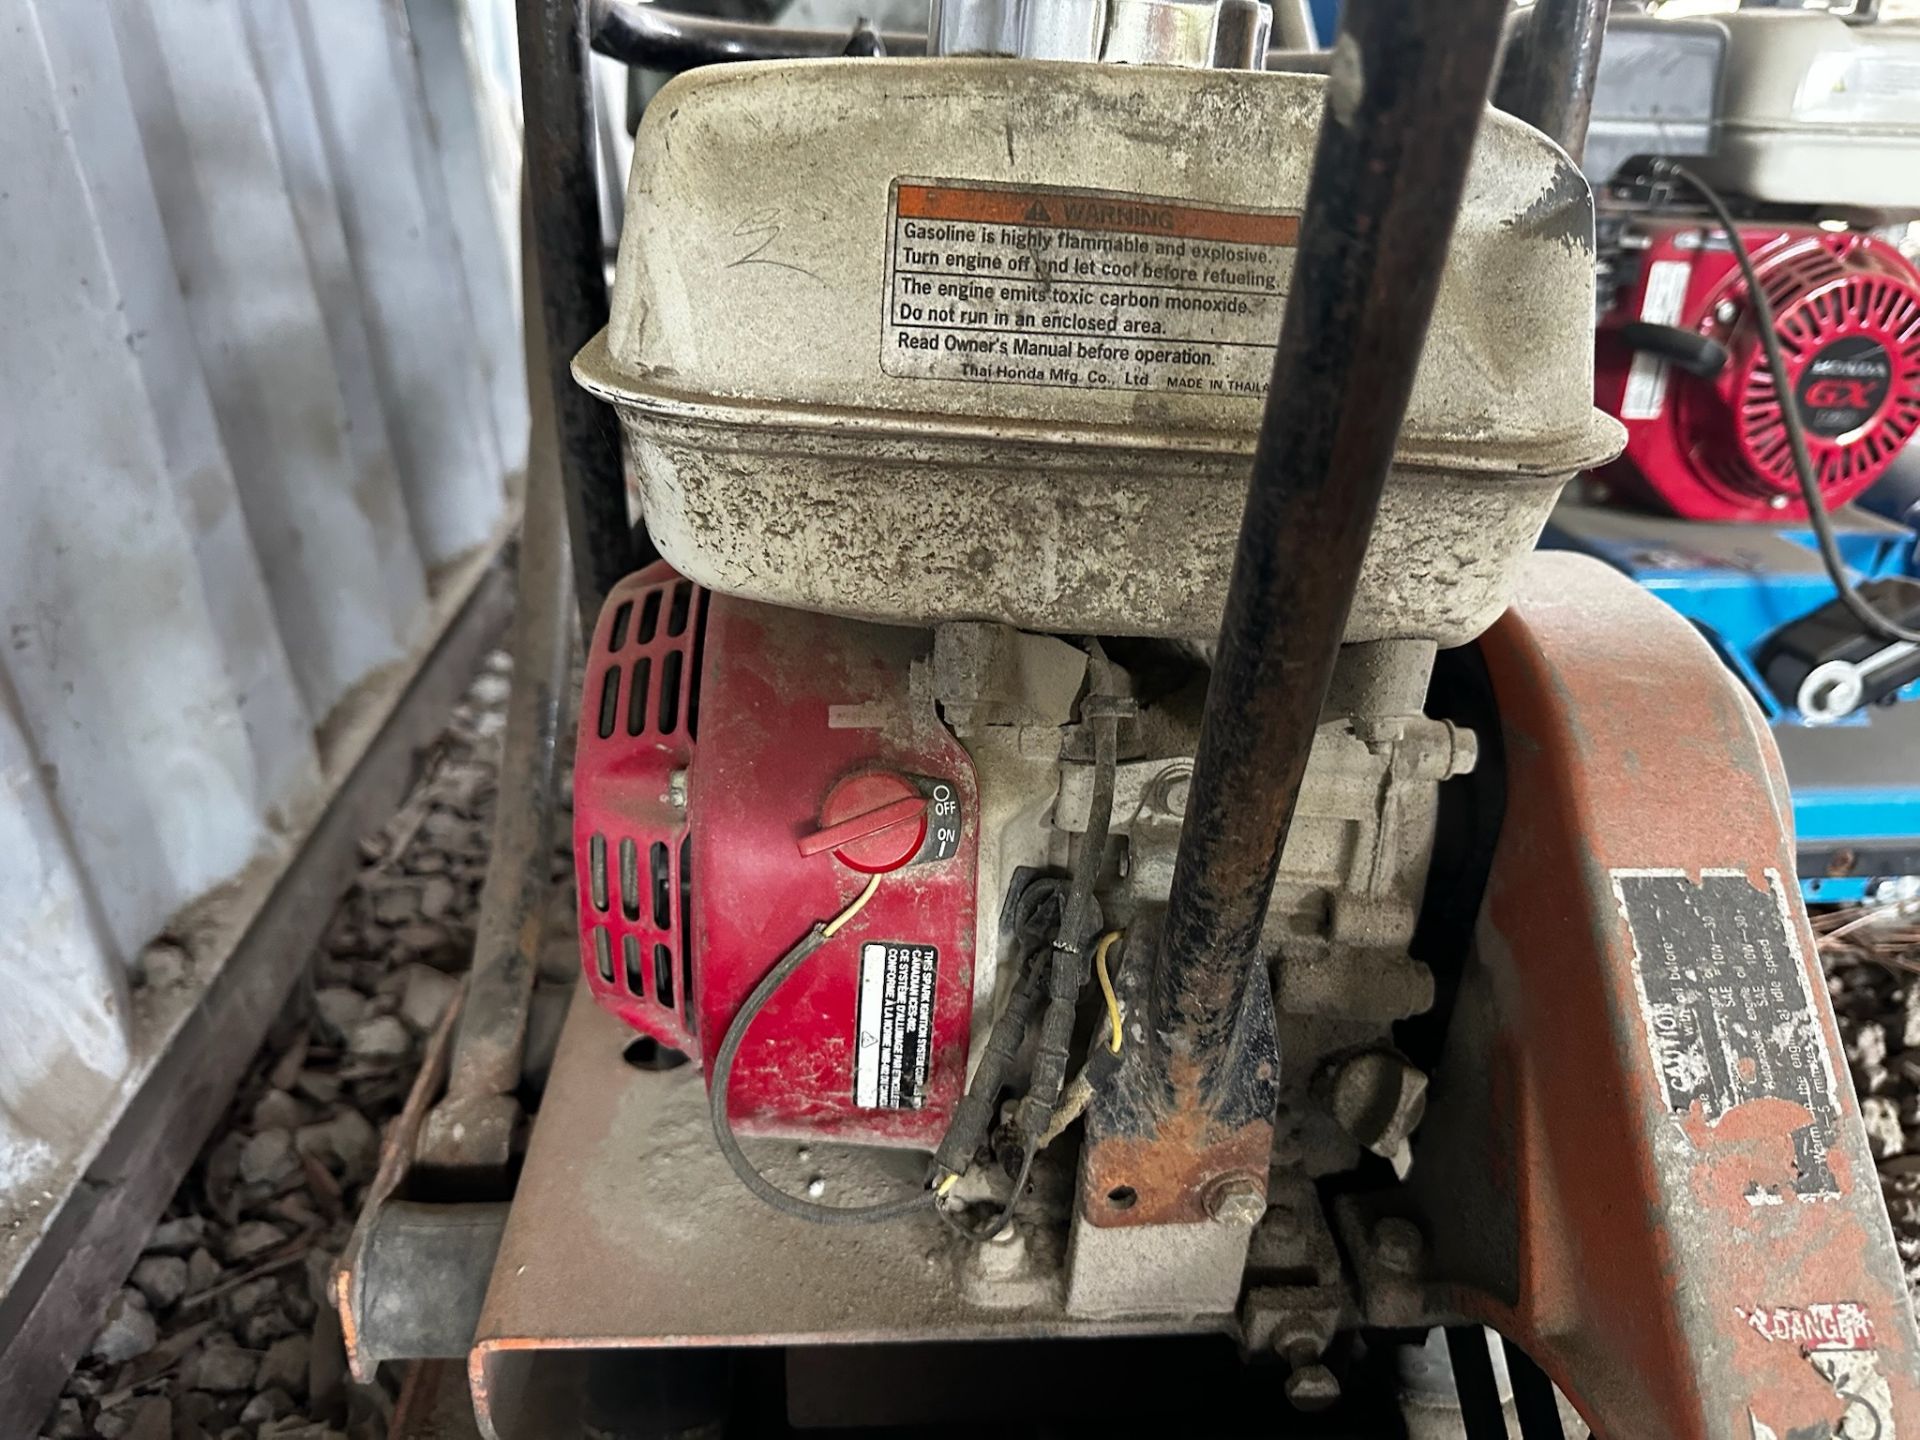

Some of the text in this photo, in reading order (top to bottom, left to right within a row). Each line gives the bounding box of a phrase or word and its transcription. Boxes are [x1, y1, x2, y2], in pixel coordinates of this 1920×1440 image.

[1063, 201, 1175, 230] WARNING
[904, 222, 1272, 265] Gasoline is highly flammable and explosive.
[903, 247, 939, 266] Turn
[945, 251, 1002, 271] engine
[1008, 256, 1031, 272] off
[1074, 258, 1095, 275] let
[1101, 261, 1137, 278] cool
[1143, 263, 1198, 282] before
[1203, 269, 1279, 290] refueling.
[902, 277, 1252, 314] The engine emits toxic carbon monoxide.
[900, 303, 1167, 335] Do not run in an enclosed area.
[898, 332, 1216, 366] Read Owner's Manual before operation.
[961, 363, 992, 378] Thai
[996, 365, 1044, 381] Honda
[1087, 370, 1115, 386] Co.,
[1167, 376, 1203, 389] MADE
[1209, 379, 1223, 390] IN
[1808, 360, 1888, 378] HONDA
[1804, 379, 1877, 408] GX
[935, 801, 956, 816] OFF
[937, 828, 956, 843] ON
[900, 949, 909, 962] CE
[924, 950, 933, 971] THIS
[1757, 938, 1779, 975] speed
[885, 949, 897, 998] CONFORME
[910, 950, 921, 995] CANADIAN
[921, 973, 932, 1002] SPARK
[1719, 986, 1736, 1008] SAE
[1752, 985, 1769, 1007] SAE
[1770, 980, 1785, 1002] idle
[884, 1007, 893, 1018] LA
[918, 1003, 930, 1037] IGNITION
[882, 1019, 893, 1047] NORME
[916, 1039, 926, 1066] SYSTEM
[1796, 1076, 1810, 1095] the
[1809, 1126, 1826, 1164] Warm
